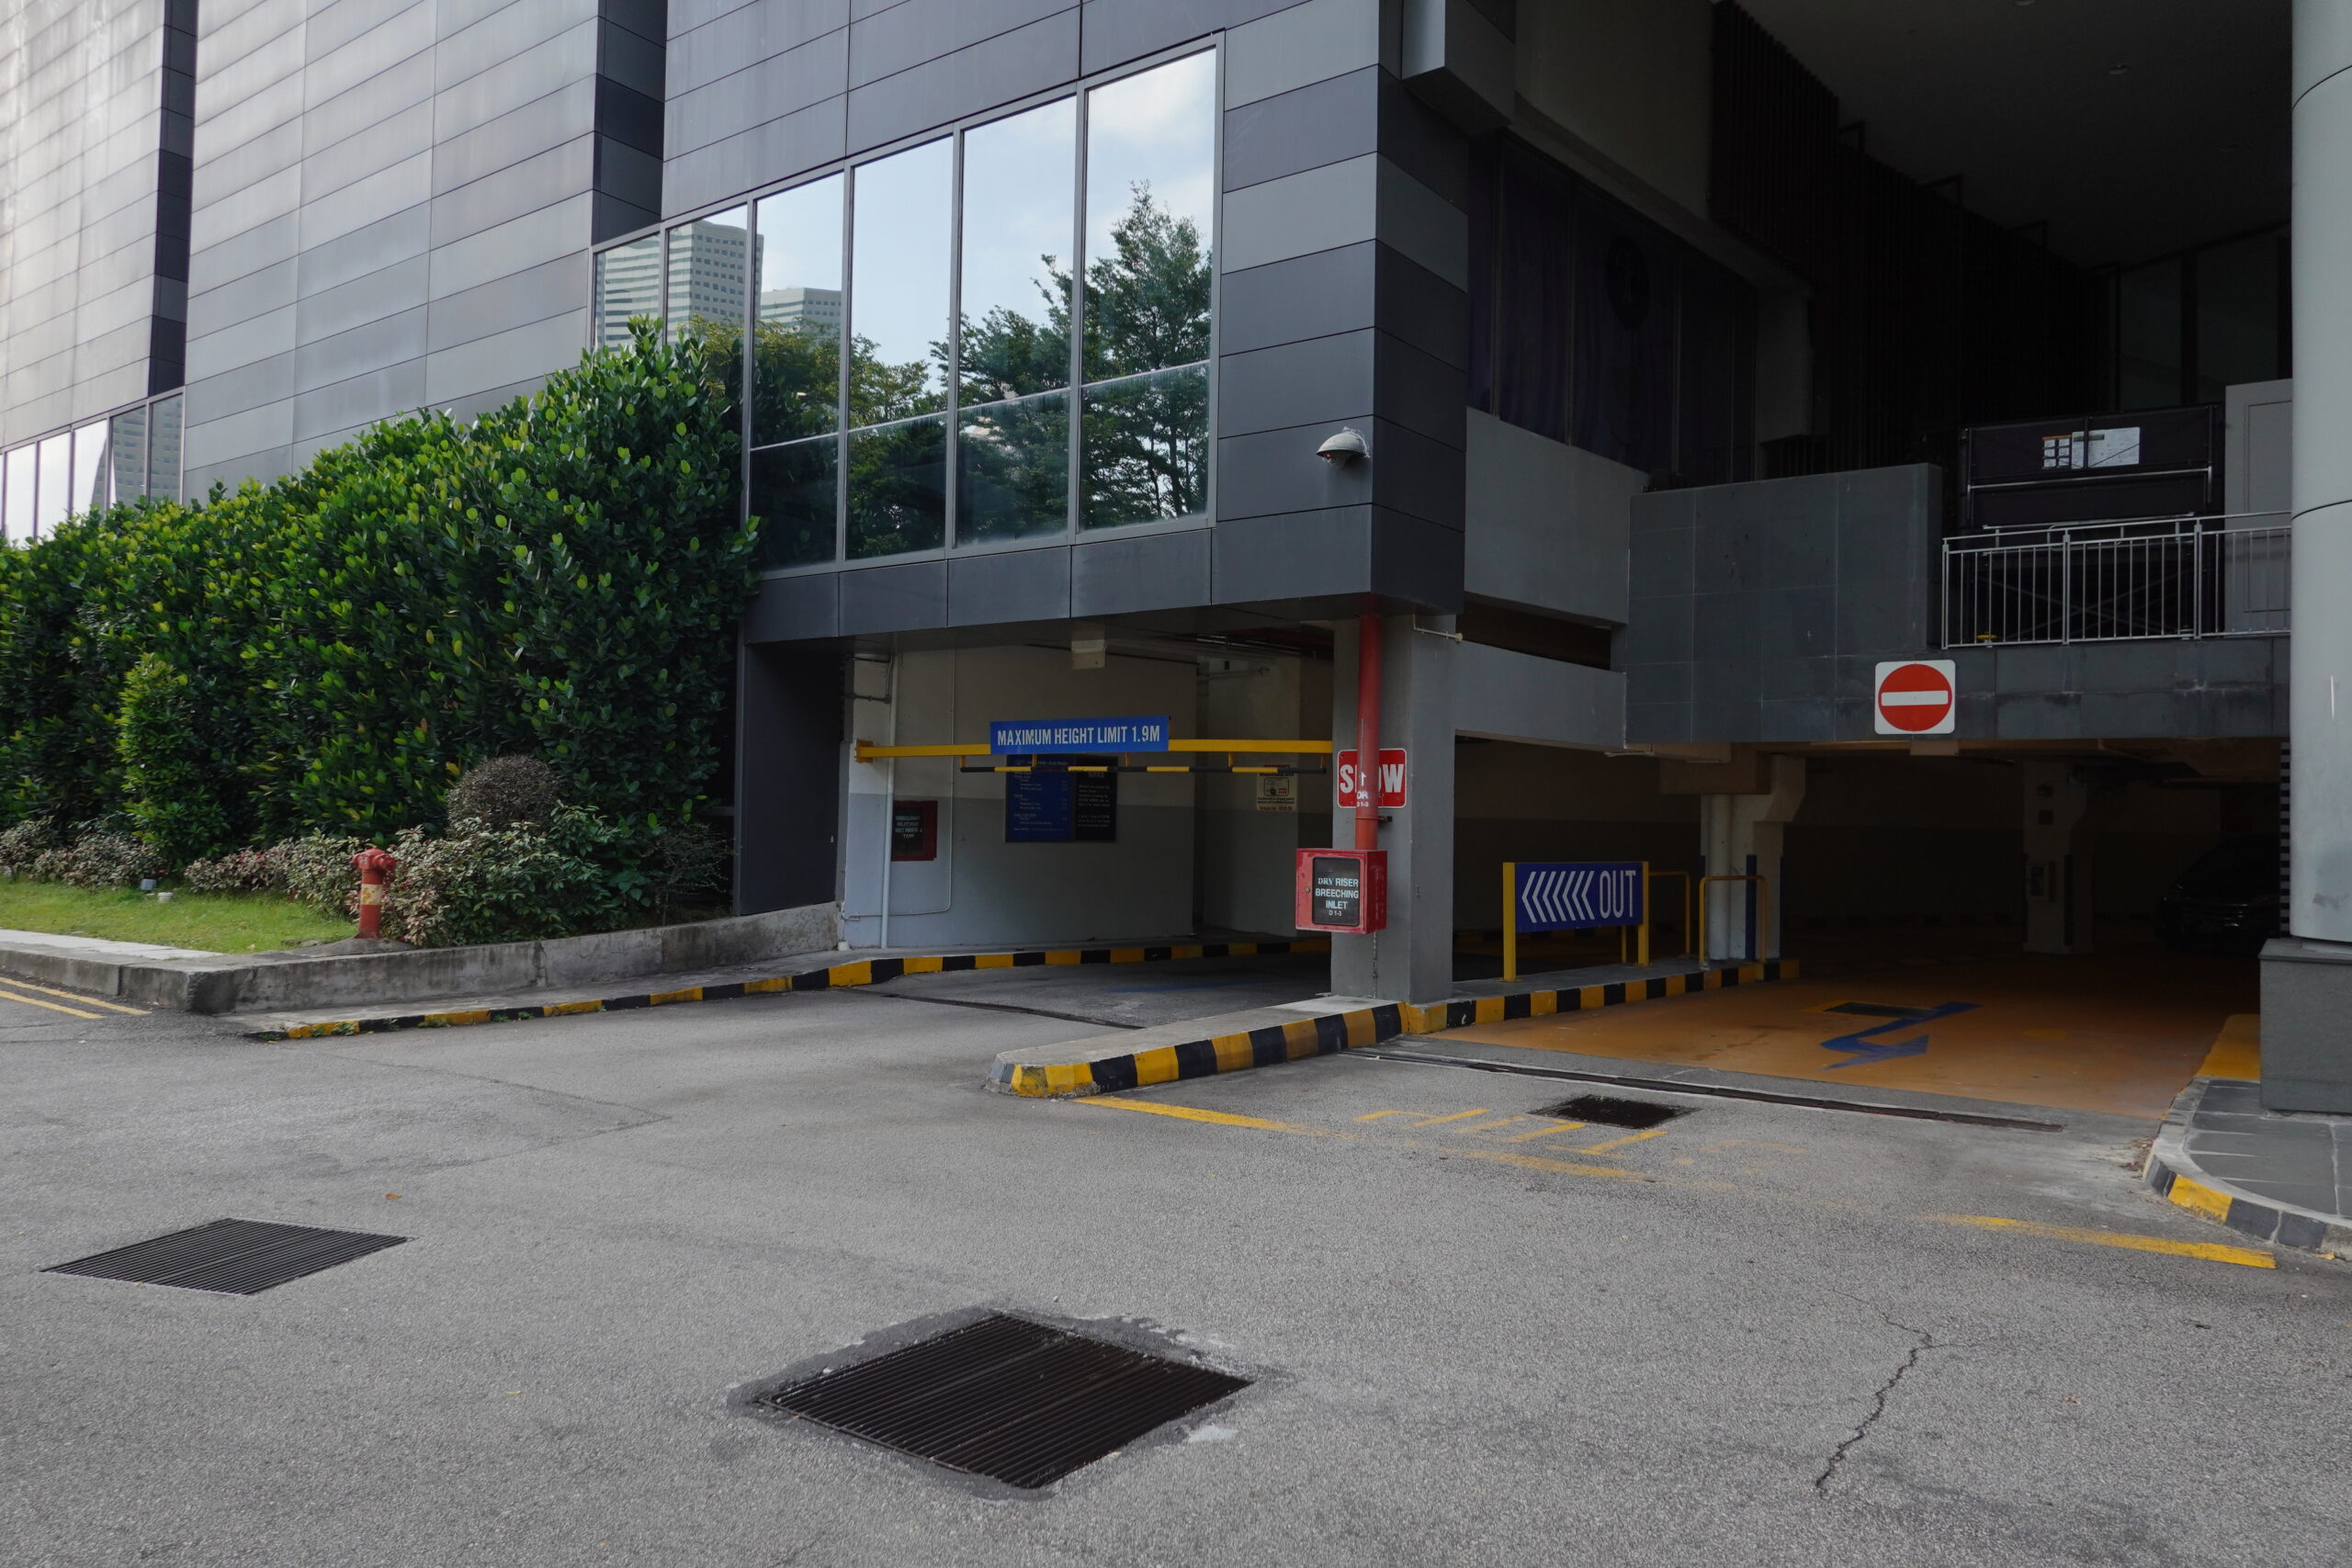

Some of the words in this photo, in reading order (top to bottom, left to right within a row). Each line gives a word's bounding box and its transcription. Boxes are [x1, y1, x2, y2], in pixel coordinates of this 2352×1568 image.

[997, 728, 1052, 746] MAXIMUM
[1054, 727, 1094, 745] HEIGHT
[1097, 726, 1128, 743] LIMIT
[1131, 725, 1160, 742] 1.9M
[1340, 763, 1405, 794] SW
[1317, 877, 1334, 886] DRY
[1335, 877, 1359, 887] RISER
[1315, 887, 1359, 898] BREECHING
[1599, 870, 1636, 919] OUT
[1325, 899, 1348, 909] INLET
